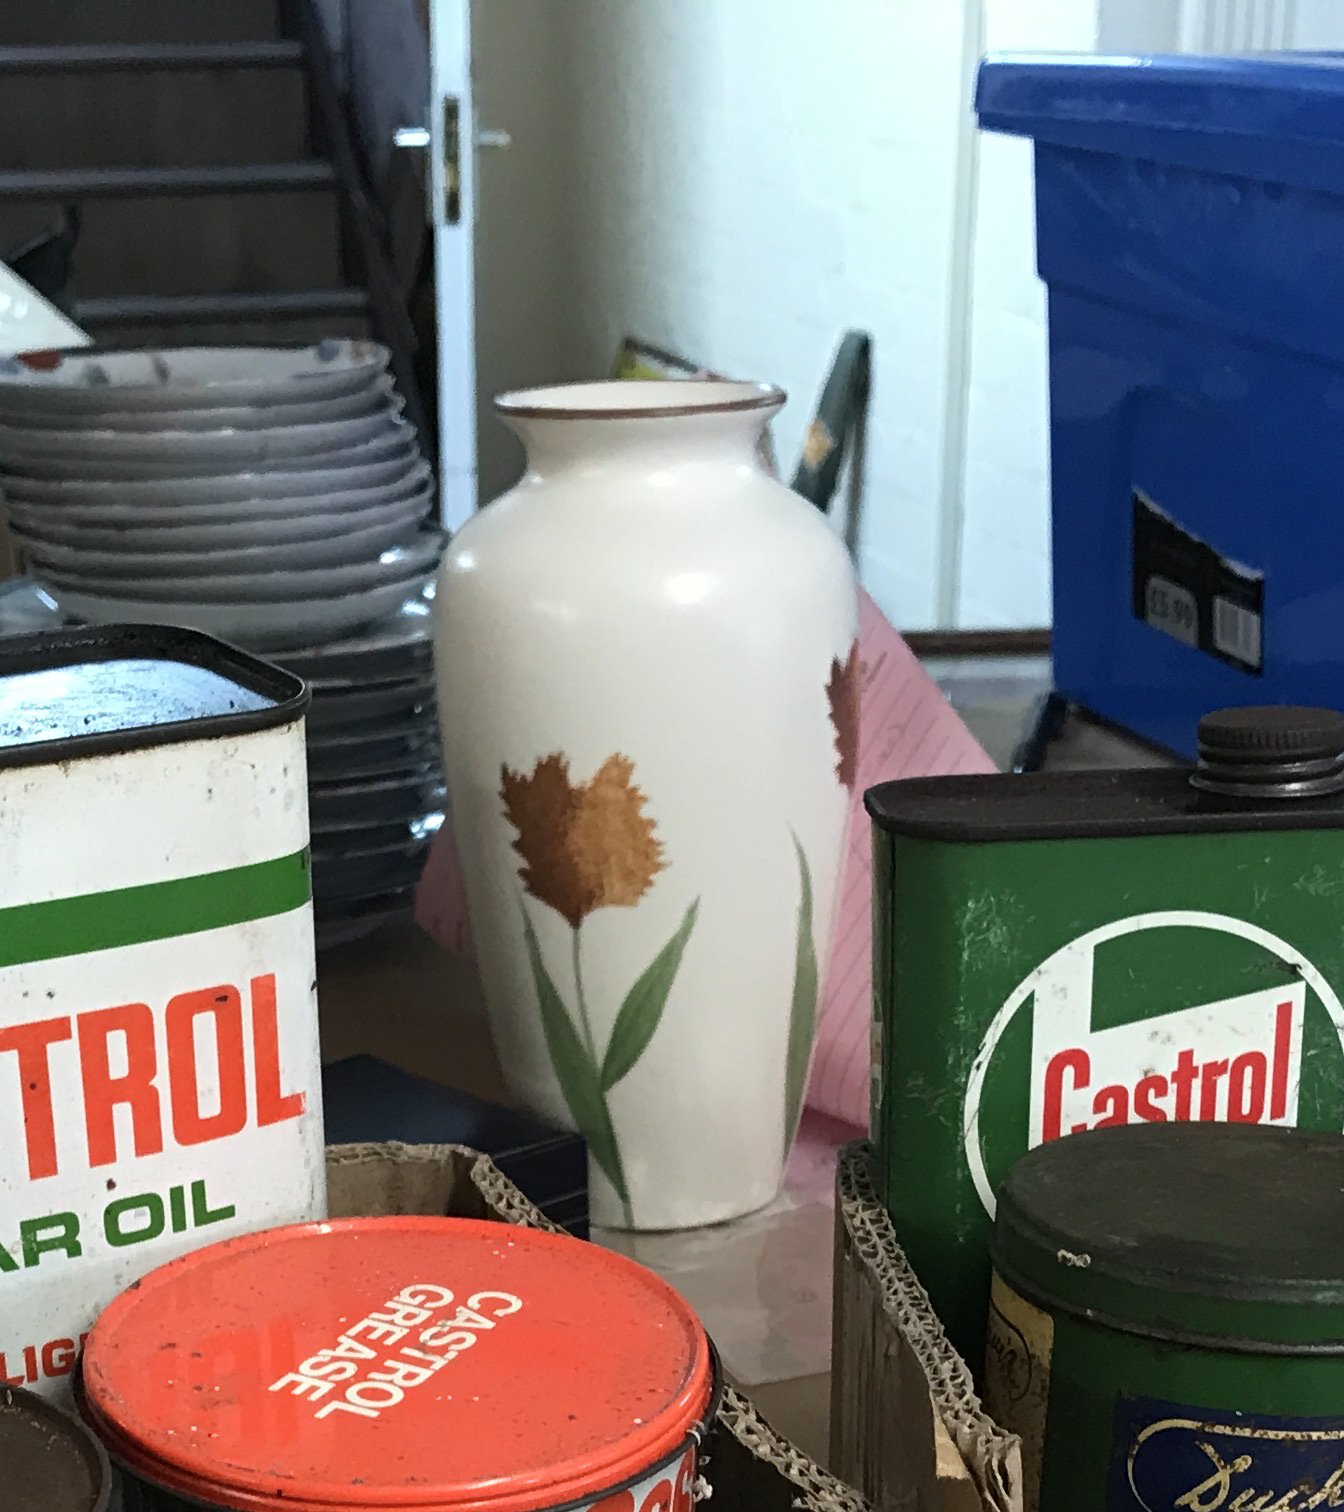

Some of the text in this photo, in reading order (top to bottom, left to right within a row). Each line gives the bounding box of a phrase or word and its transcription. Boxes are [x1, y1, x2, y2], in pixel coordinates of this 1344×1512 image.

[1042, 1000, 1294, 1144] Castrol
[103, 1179, 236, 1249] OIL
[268, 1282, 456, 1401] GREASE
[314, 1288, 524, 1420] CASTROL
